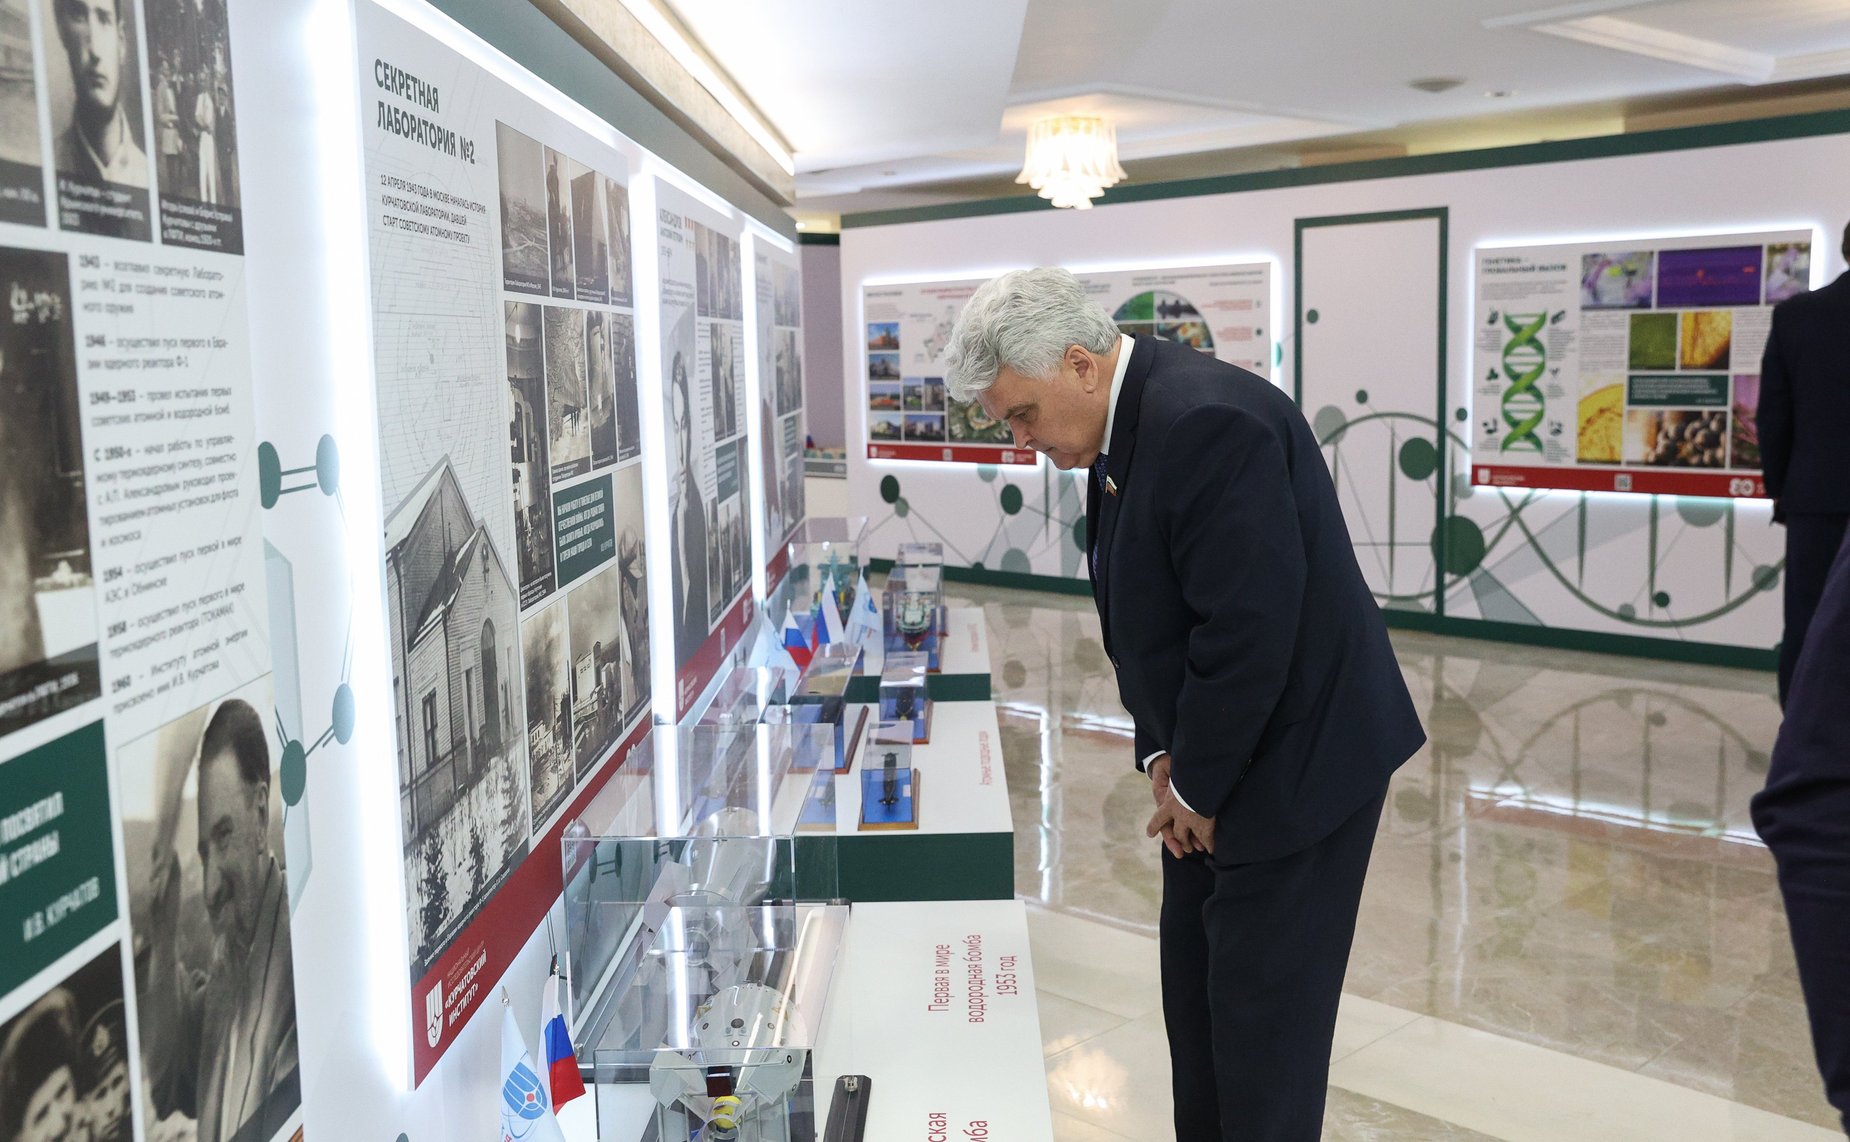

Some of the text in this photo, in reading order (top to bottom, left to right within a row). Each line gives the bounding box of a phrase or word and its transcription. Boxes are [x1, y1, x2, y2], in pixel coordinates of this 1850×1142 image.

[375, 58, 439, 113] СЕКРЕТНАЯ
[378, 100, 475, 164] ЛАБОРАТОРИЯ №2
[445, 948, 487, 1008] «КУРЧАТОВСКИЙ
[936, 944, 955, 967] мире
[962, 934, 989, 1022] водородная бомба
[995, 955, 1018, 995] 1953 год
[928, 976, 955, 1011] Первая
